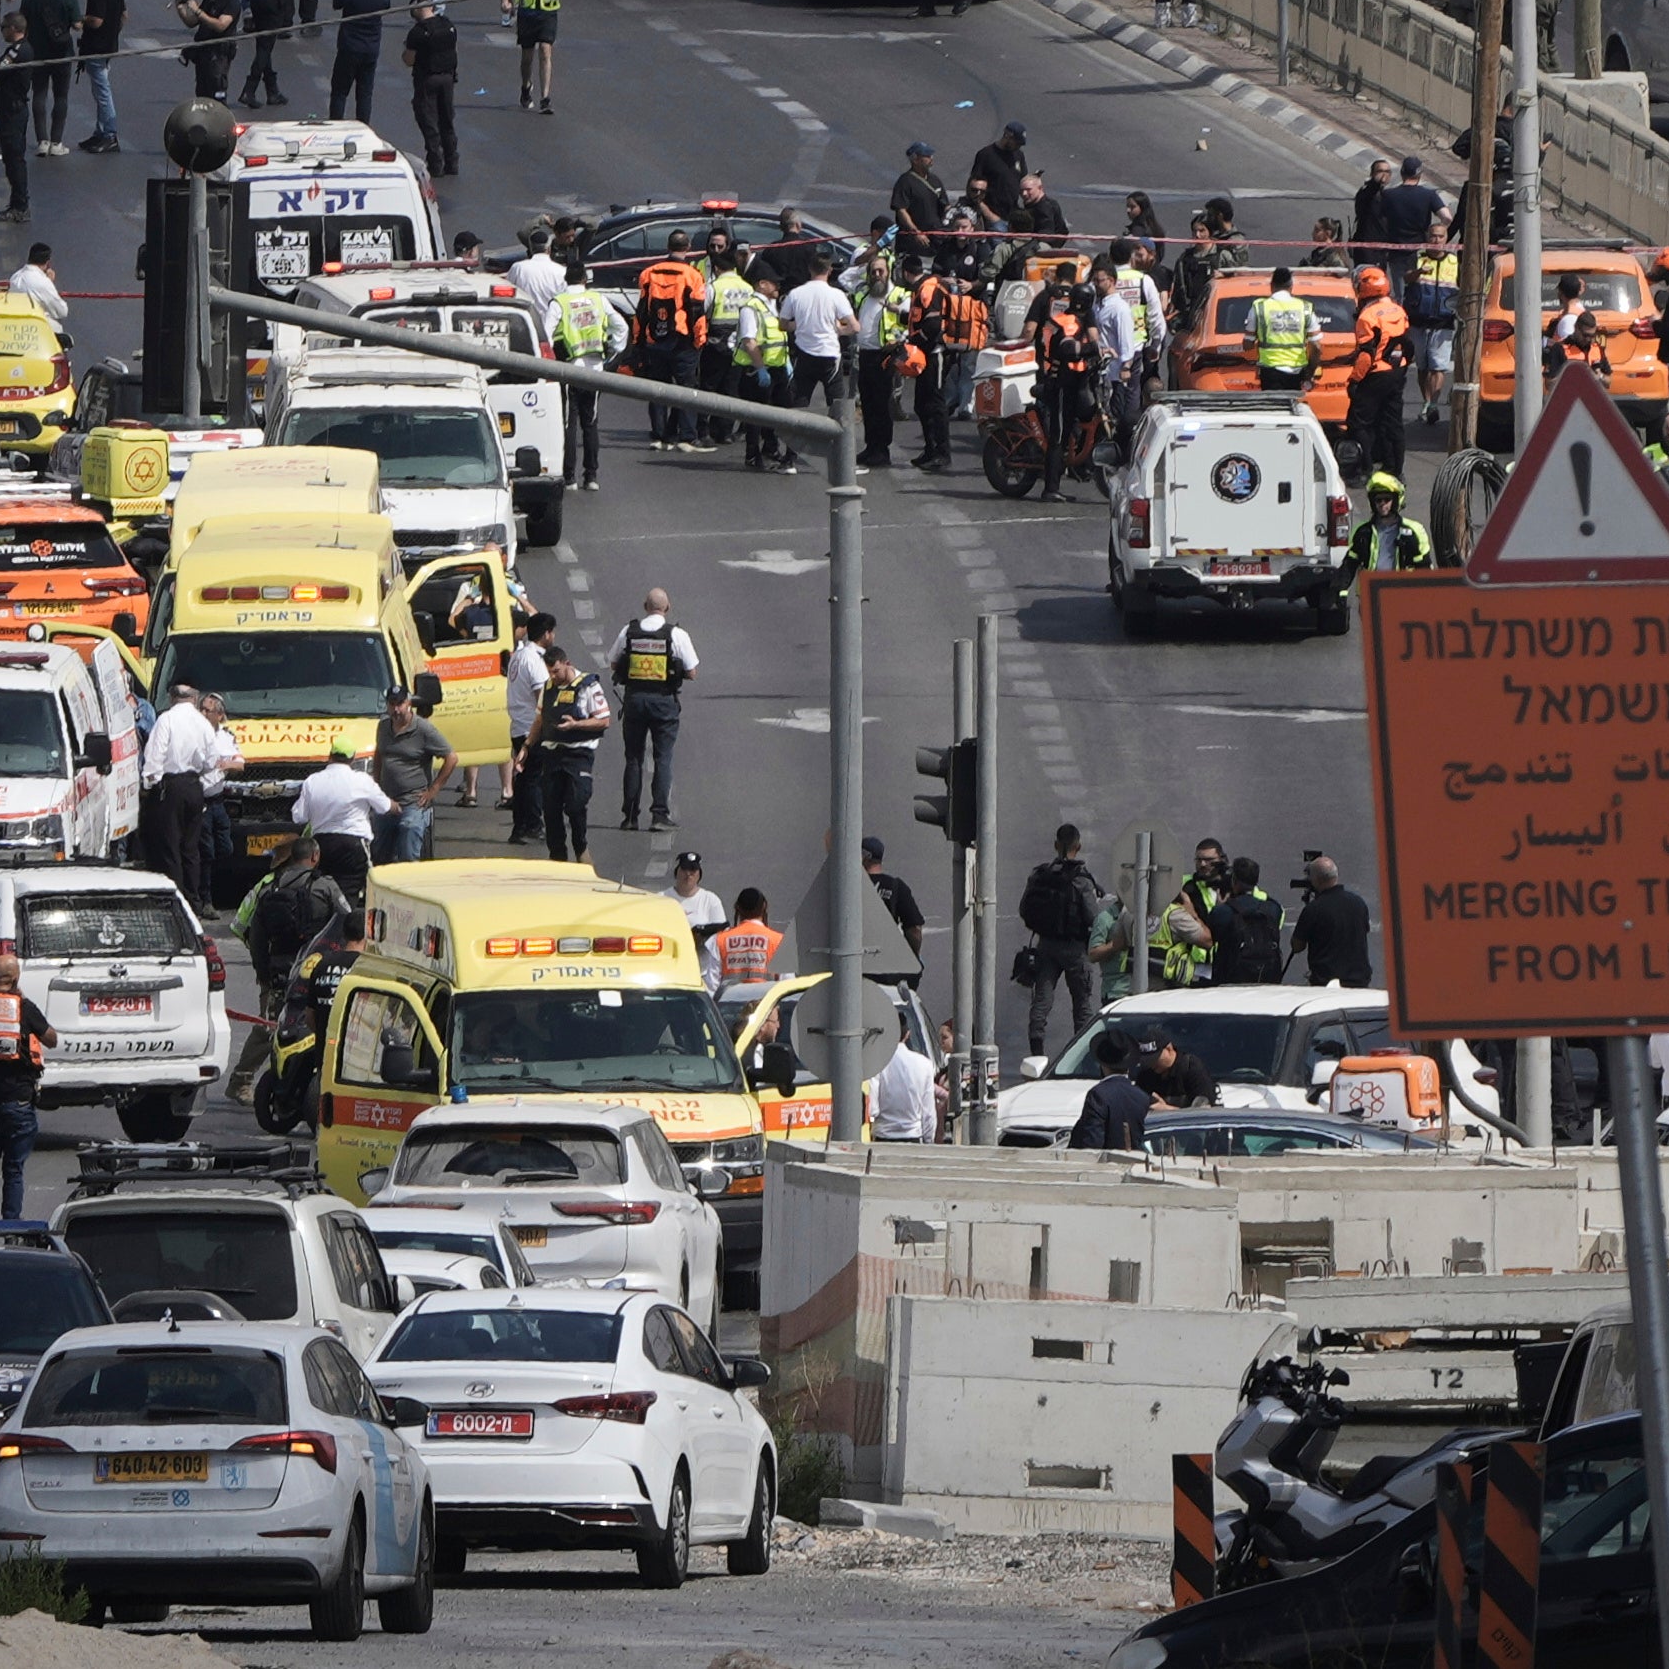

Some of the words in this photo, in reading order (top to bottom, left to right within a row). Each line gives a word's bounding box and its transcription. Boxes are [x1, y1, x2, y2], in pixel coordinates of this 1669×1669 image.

[1399, 607, 1613, 662] משתלבות
[1442, 750, 1573, 801] تندمج
[1423, 880, 1618, 921] MERGING
[531, 966, 622, 982] פראמדיק
[1487, 945, 1621, 983] FROM
[63, 1040, 116, 1054] הגבול
[126, 1040, 175, 1053] משמר
